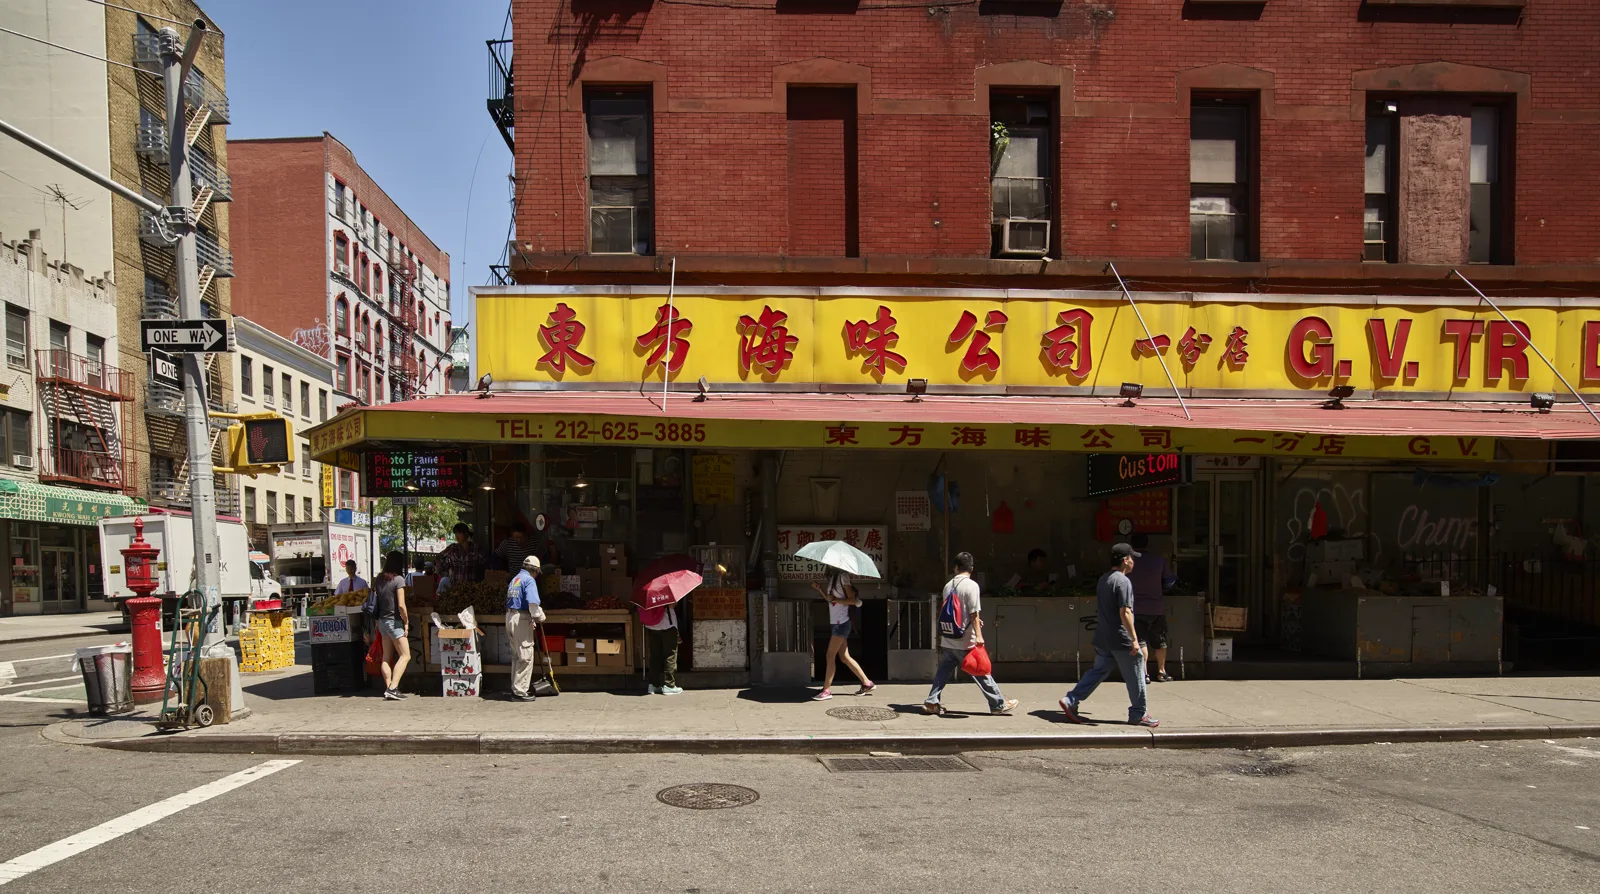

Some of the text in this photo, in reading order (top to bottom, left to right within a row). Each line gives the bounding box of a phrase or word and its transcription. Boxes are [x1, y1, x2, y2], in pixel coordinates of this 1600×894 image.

[153, 330, 214, 343] ONE WAY
[538, 303, 1093, 377] 東方海味公司
[161, 362, 178, 378] ONE
[496, 419, 706, 442] TEL: 212-625-3885
[825, 425, 1172, 449] 東方海味公司
[374, 454, 445, 465] Photo Frames
[1119, 453, 1178, 479] Custom
[375, 465, 453, 477] Picture Frames
[420, 477, 458, 487] Frames
[779, 563, 804, 571] TEL:
[312, 620, 348, 633] NORDIC
